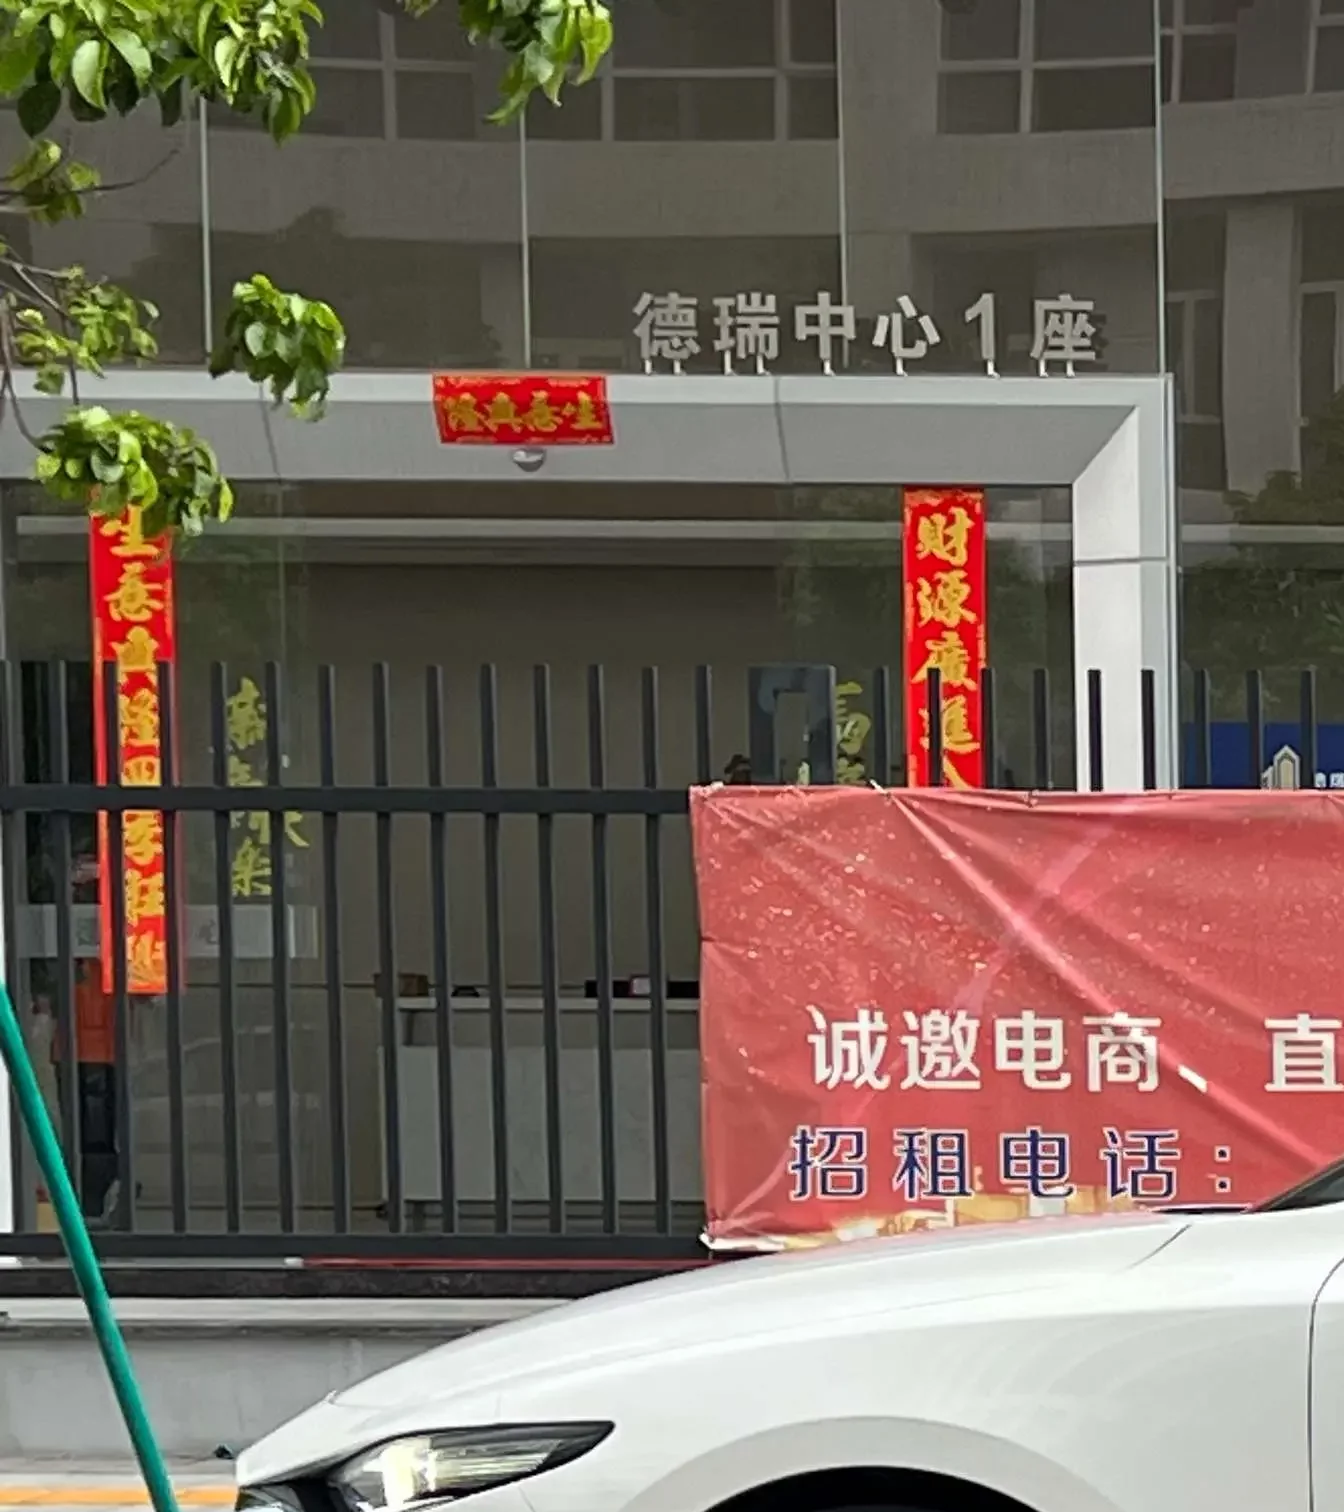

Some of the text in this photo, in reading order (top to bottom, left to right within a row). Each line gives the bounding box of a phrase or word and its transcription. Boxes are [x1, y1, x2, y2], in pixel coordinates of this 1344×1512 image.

[632, 291, 1096, 360] 德瑞中心1座
[909, 506, 981, 789] 財源廣進
